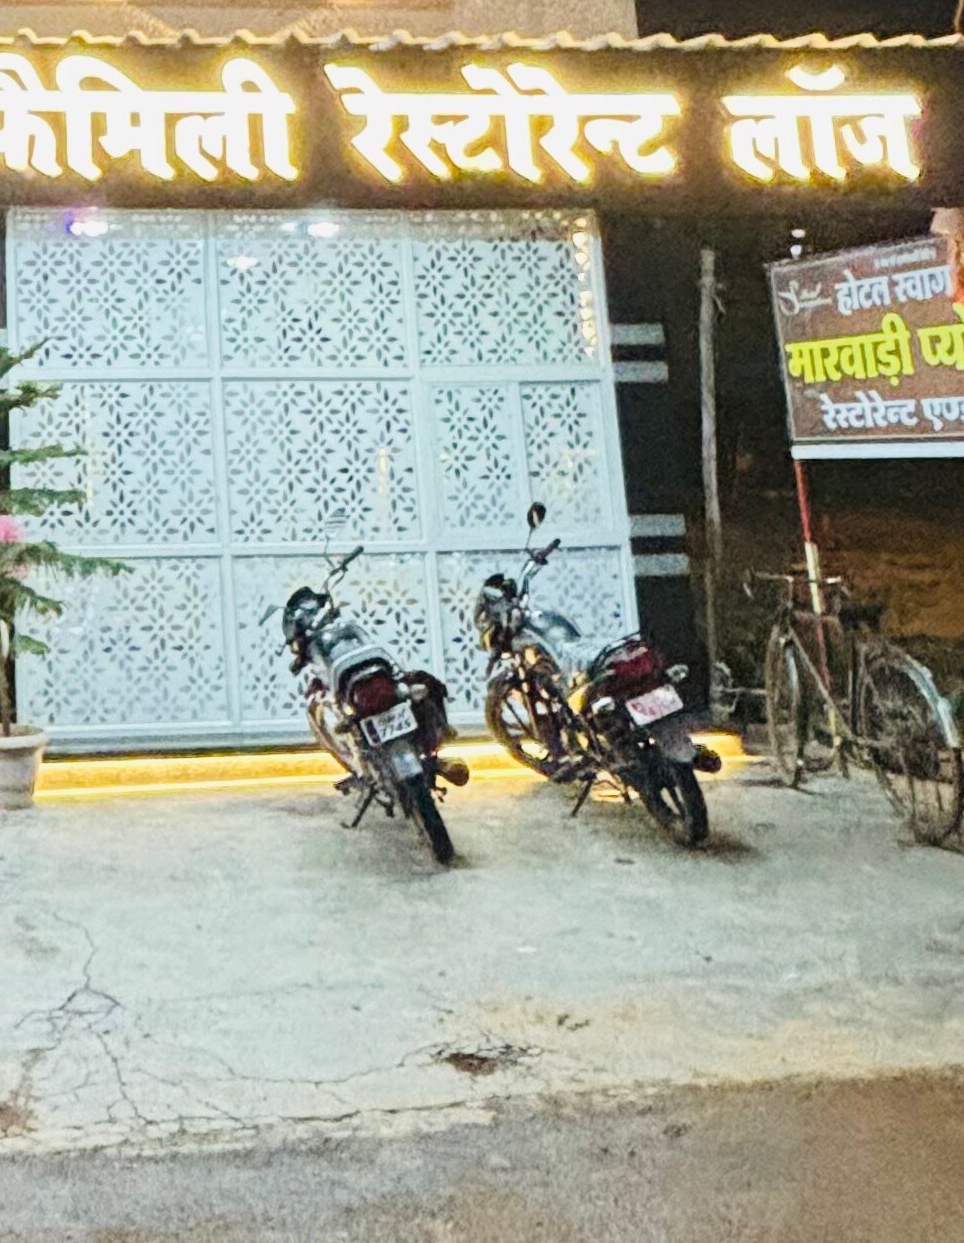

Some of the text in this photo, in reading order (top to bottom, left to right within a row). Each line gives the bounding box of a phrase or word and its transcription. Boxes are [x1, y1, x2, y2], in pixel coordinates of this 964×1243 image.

[721, 65, 922, 180] लॉज
[835, 269, 891, 316] होटल
[785, 312, 915, 387] मारवाड़ी
